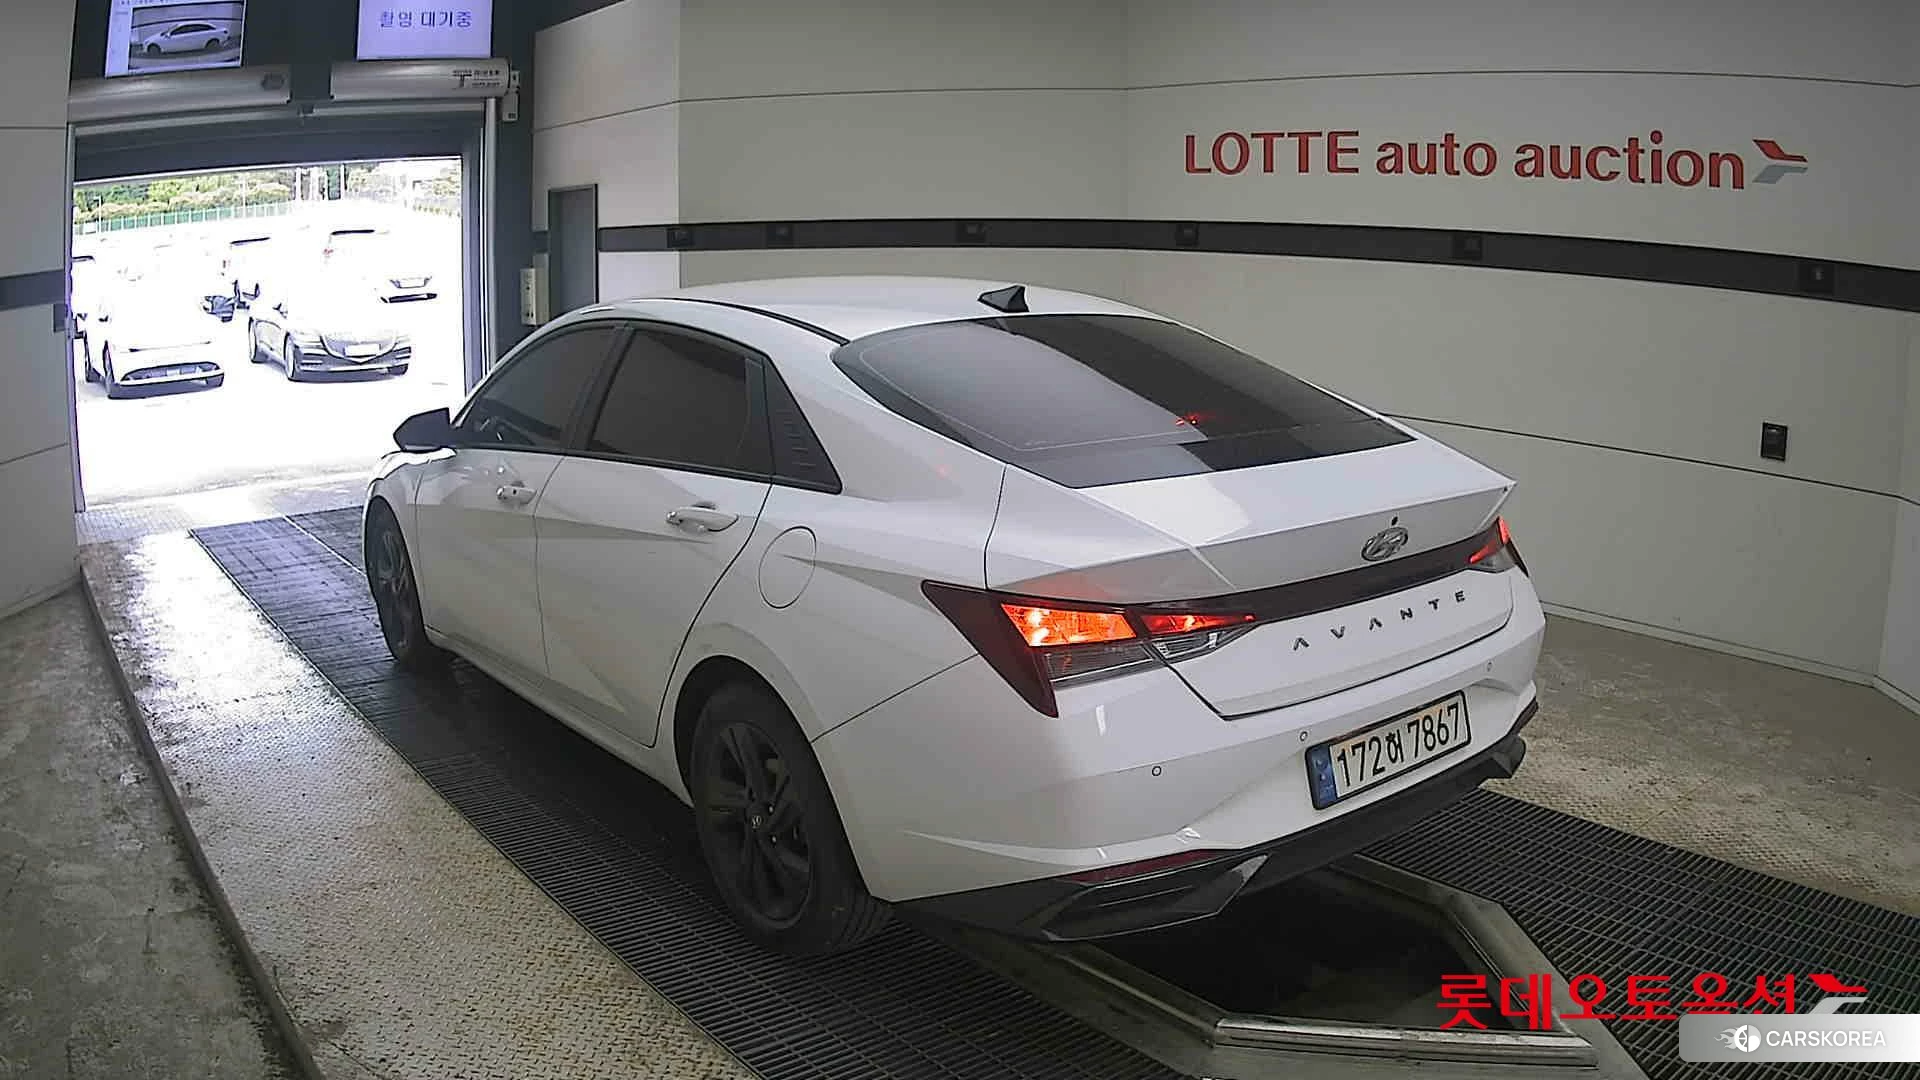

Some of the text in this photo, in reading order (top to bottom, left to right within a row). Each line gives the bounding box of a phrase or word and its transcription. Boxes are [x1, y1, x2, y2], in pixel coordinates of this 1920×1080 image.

[421, 9, 472, 28] 대기중
[1184, 129, 1745, 189] LOTTE auto auction
[1292, 590, 1466, 651] AVANTE
[1407, 702, 1459, 759] 7867
